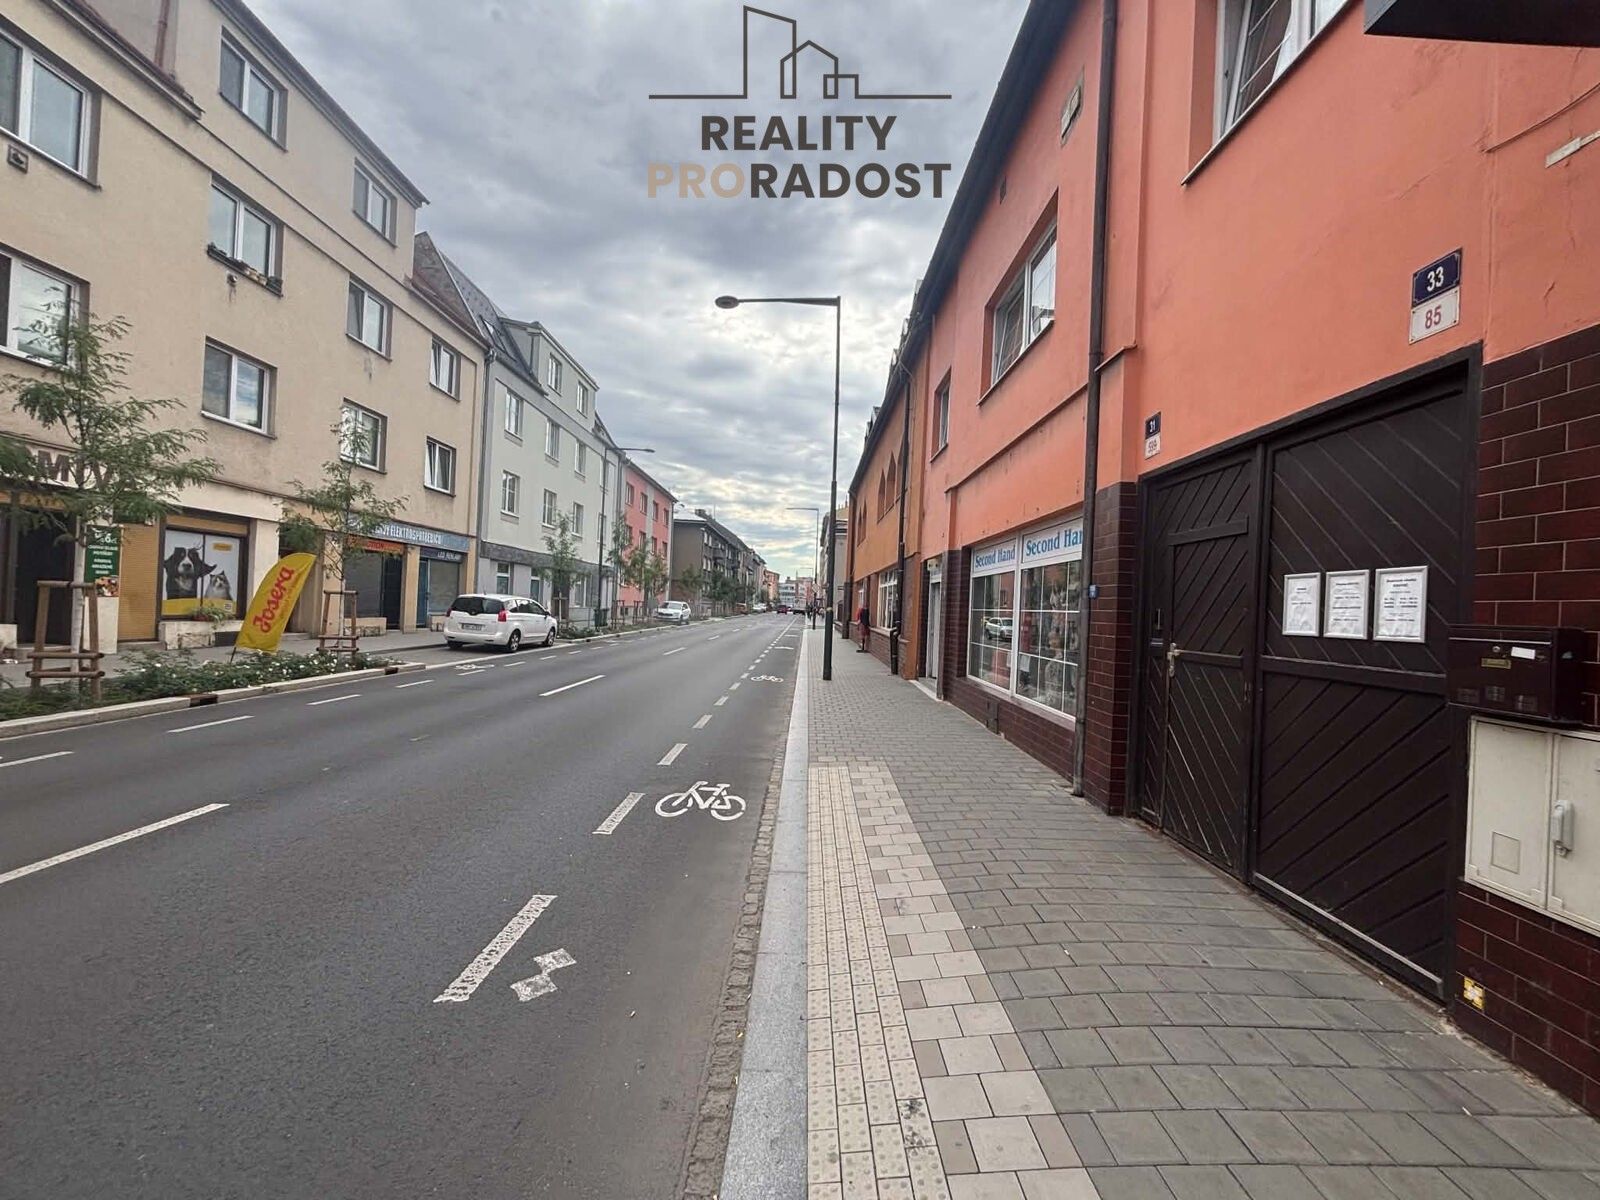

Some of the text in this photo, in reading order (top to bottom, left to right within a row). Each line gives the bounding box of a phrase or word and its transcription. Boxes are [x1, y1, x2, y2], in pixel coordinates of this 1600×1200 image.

[1426, 266, 1444, 292] 33
[1425, 305, 1442, 329] 85
[975, 544, 1016, 568] Second Hand
[1026, 532, 1060, 556] Second
[252, 566, 295, 633] Josera
